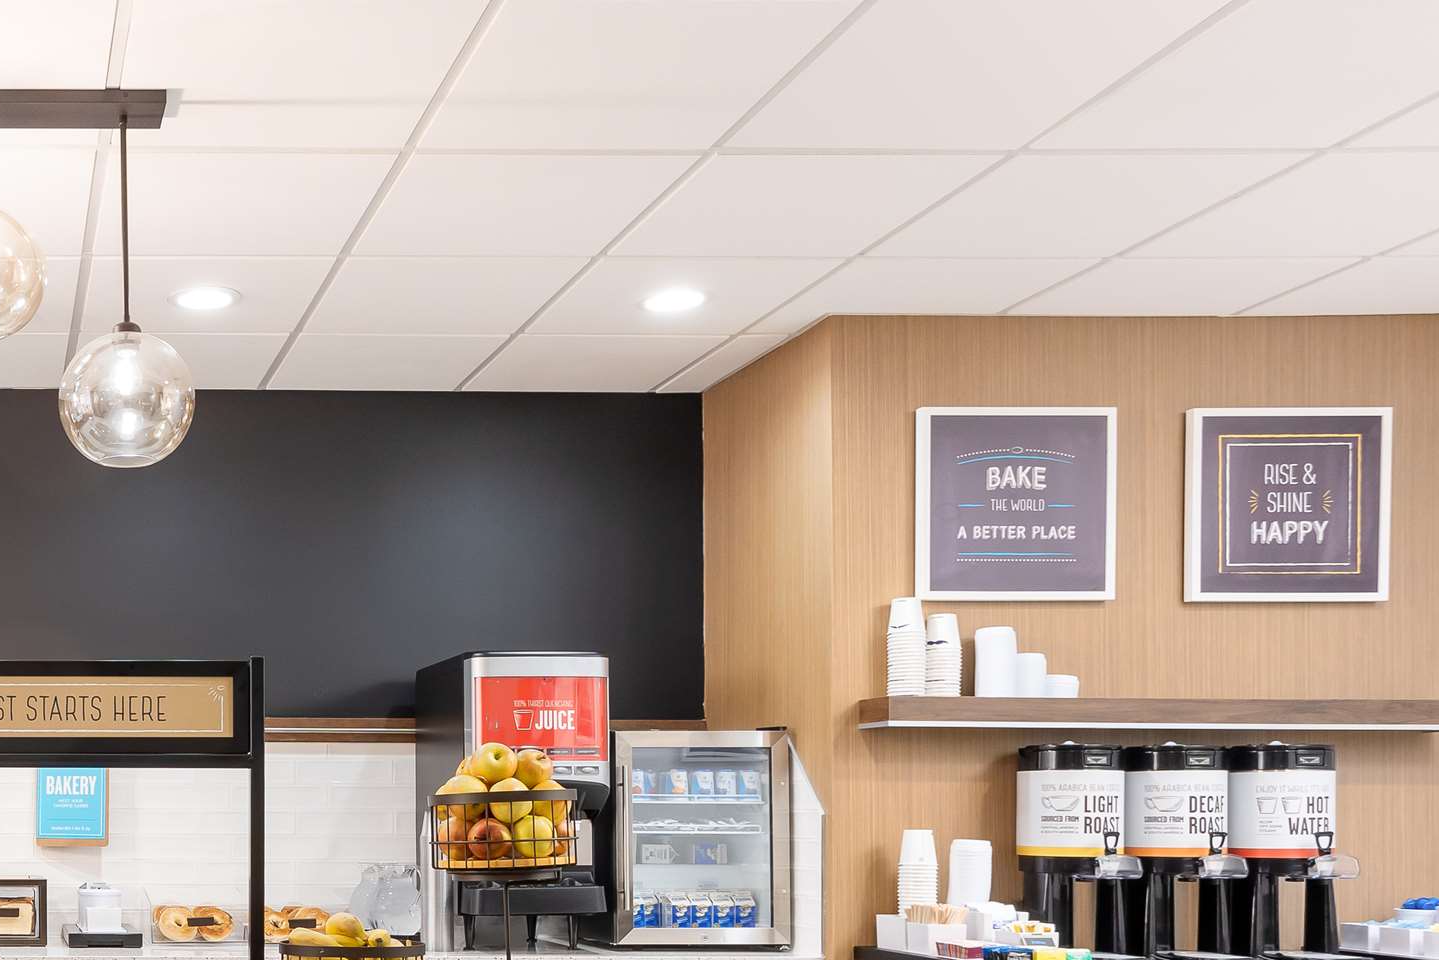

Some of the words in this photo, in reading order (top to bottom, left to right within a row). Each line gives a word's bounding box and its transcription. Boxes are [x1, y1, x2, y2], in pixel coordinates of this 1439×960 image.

[986, 465, 1047, 490] BAKE
[1264, 463, 1299, 485] RISE
[1302, 462, 1317, 485] &
[990, 499, 1009, 511] THE
[1010, 499, 1045, 512] WORLD
[1266, 491, 1313, 513] SHINE
[957, 525, 968, 540] A
[972, 525, 1027, 540] BETTER
[1031, 525, 1077, 540] PLACE
[1250, 520, 1329, 544] HAPPY
[25, 695, 102, 722] STARTS
[113, 695, 167, 722] HERE
[534, 709, 576, 731] JUICE
[45, 775, 97, 796] BAKERY
[1083, 795, 1119, 813] LIGHT
[1188, 795, 1225, 814] DECAF
[1306, 796, 1330, 814] HOT
[1064, 815, 1080, 823] FROM
[1083, 816, 1120, 834] ROAST
[1169, 815, 1185, 823] FROM
[1188, 816, 1225, 834] ROAST
[1288, 817, 1330, 835] WATER
